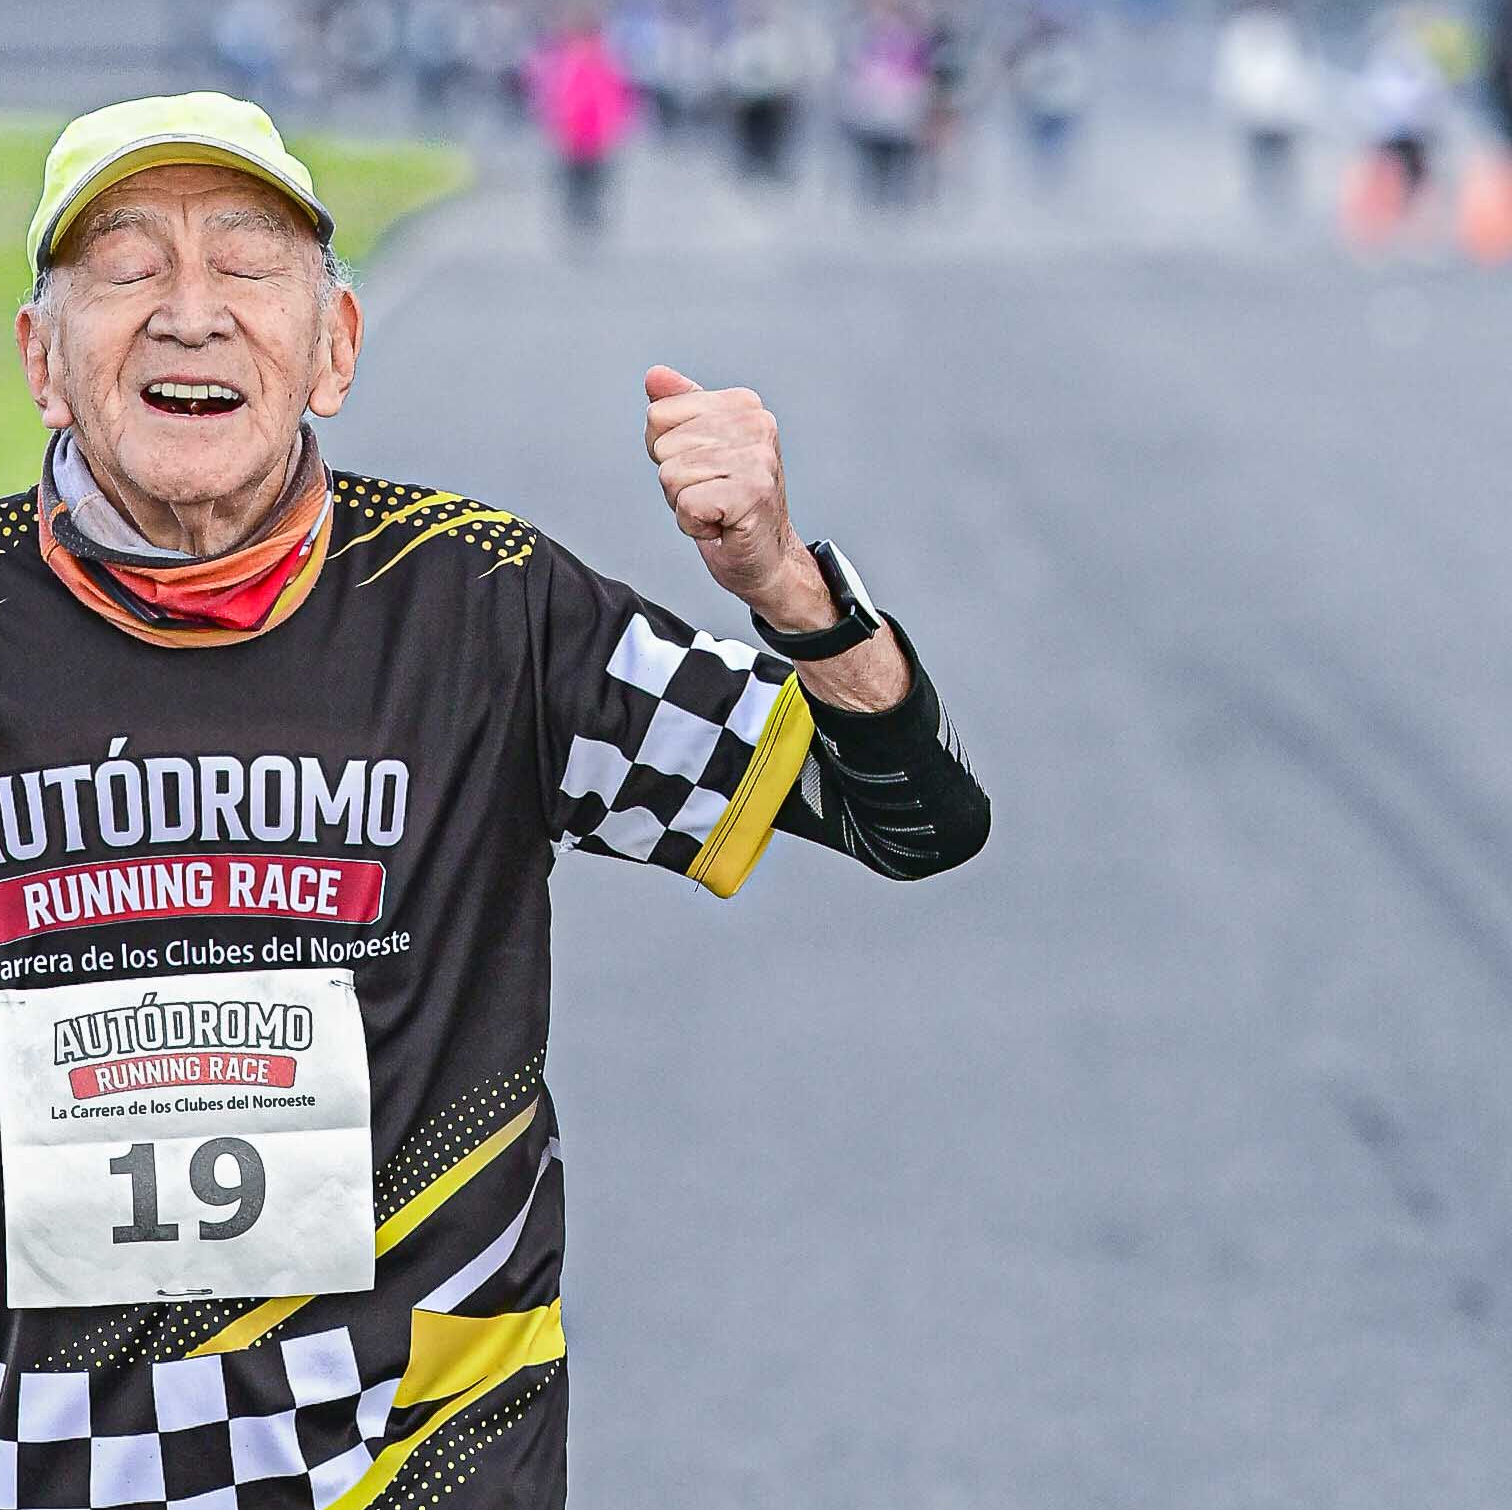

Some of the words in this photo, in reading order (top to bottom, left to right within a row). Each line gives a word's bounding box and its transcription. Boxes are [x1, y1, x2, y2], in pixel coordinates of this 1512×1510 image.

[22, 861, 214, 931] RUNNING
[228, 862, 342, 916] RACE
[81, 945, 114, 972] de
[121, 943, 158, 969] los
[165, 939, 254, 967] Clubes
[261, 936, 303, 963] del
[310, 930, 411, 963] Noroeste
[54, 992, 313, 1066] AUTÓDROMO
[95, 1057, 201, 1092] RUNNING
[208, 1056, 271, 1084] RACE
[51, 1106, 67, 1120] La
[71, 1103, 125, 1119] Carrera
[128, 1101, 147, 1115] de
[150, 1099, 171, 1114] los
[175, 1097, 223, 1112] Clubes
[227, 1095, 249, 1110] del
[252, 1094, 316, 1109] Noroeste
[109, 1136, 266, 1244] 19
